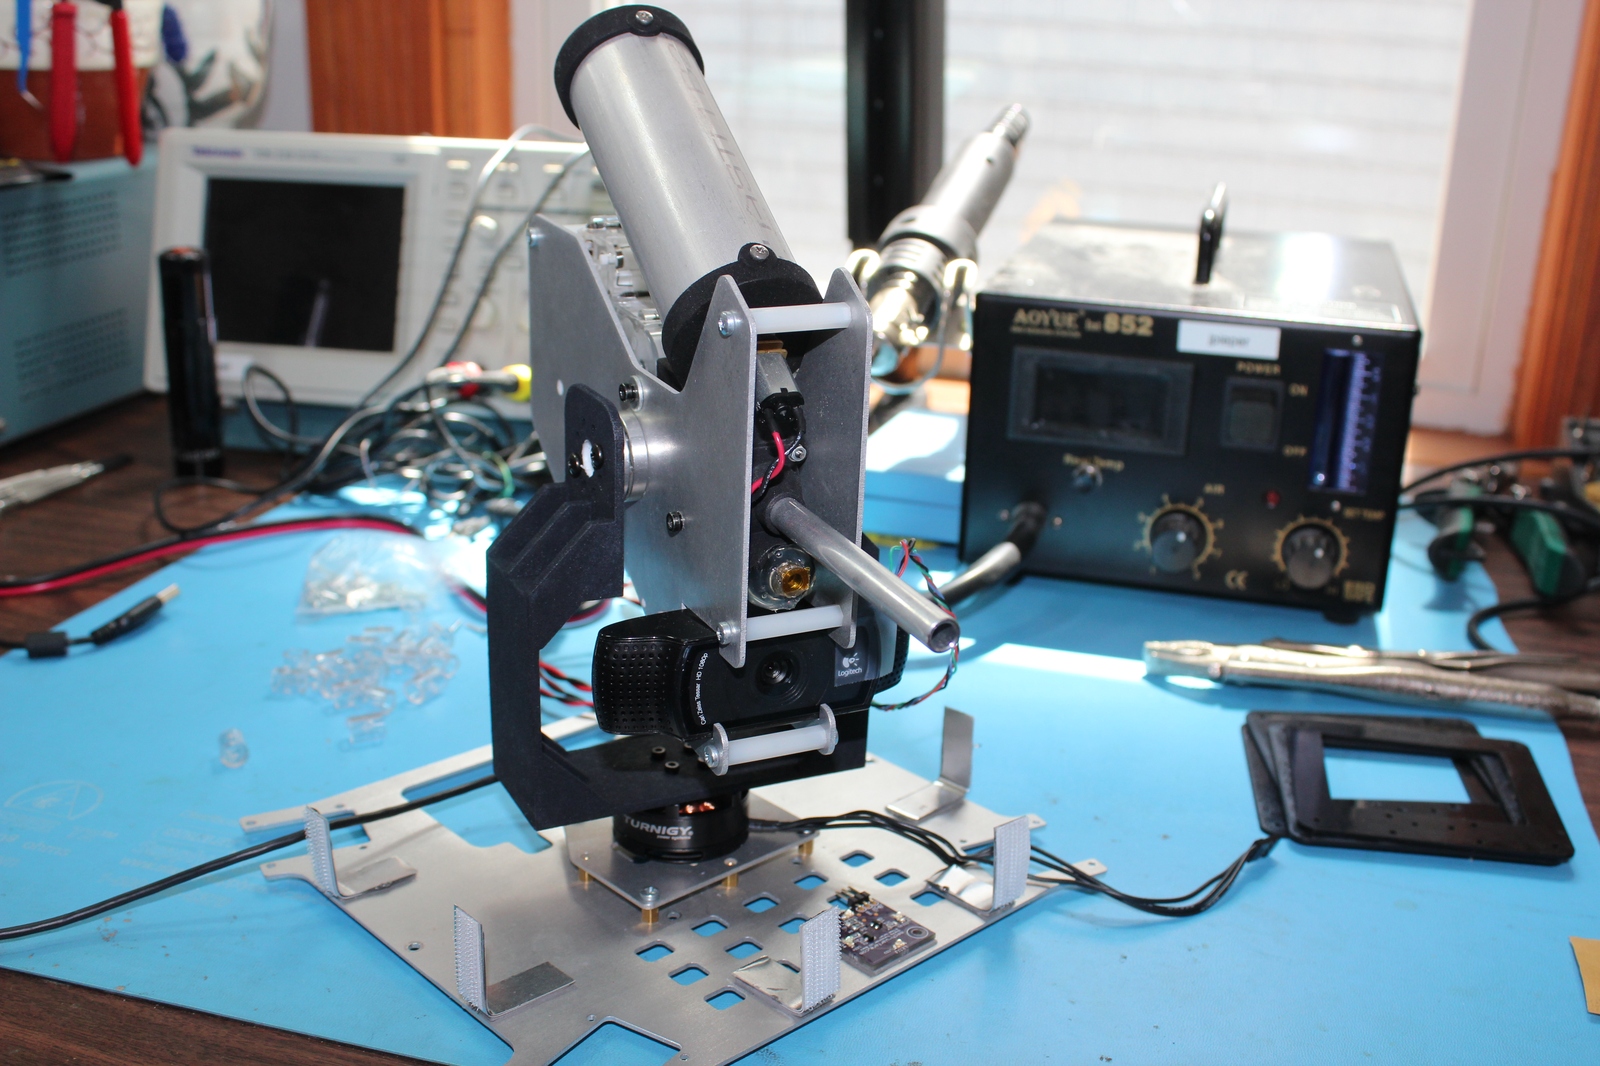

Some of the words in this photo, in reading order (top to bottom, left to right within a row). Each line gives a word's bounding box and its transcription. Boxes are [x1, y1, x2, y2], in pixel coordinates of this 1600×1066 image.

[1103, 312, 1154, 337] 852
[1235, 360, 1281, 375] POWER
[1288, 383, 1309, 397] ON
[698, 652, 708, 670] 1080p
[837, 667, 863, 677] Logitech
[623, 813, 694, 836] TURNIGY
